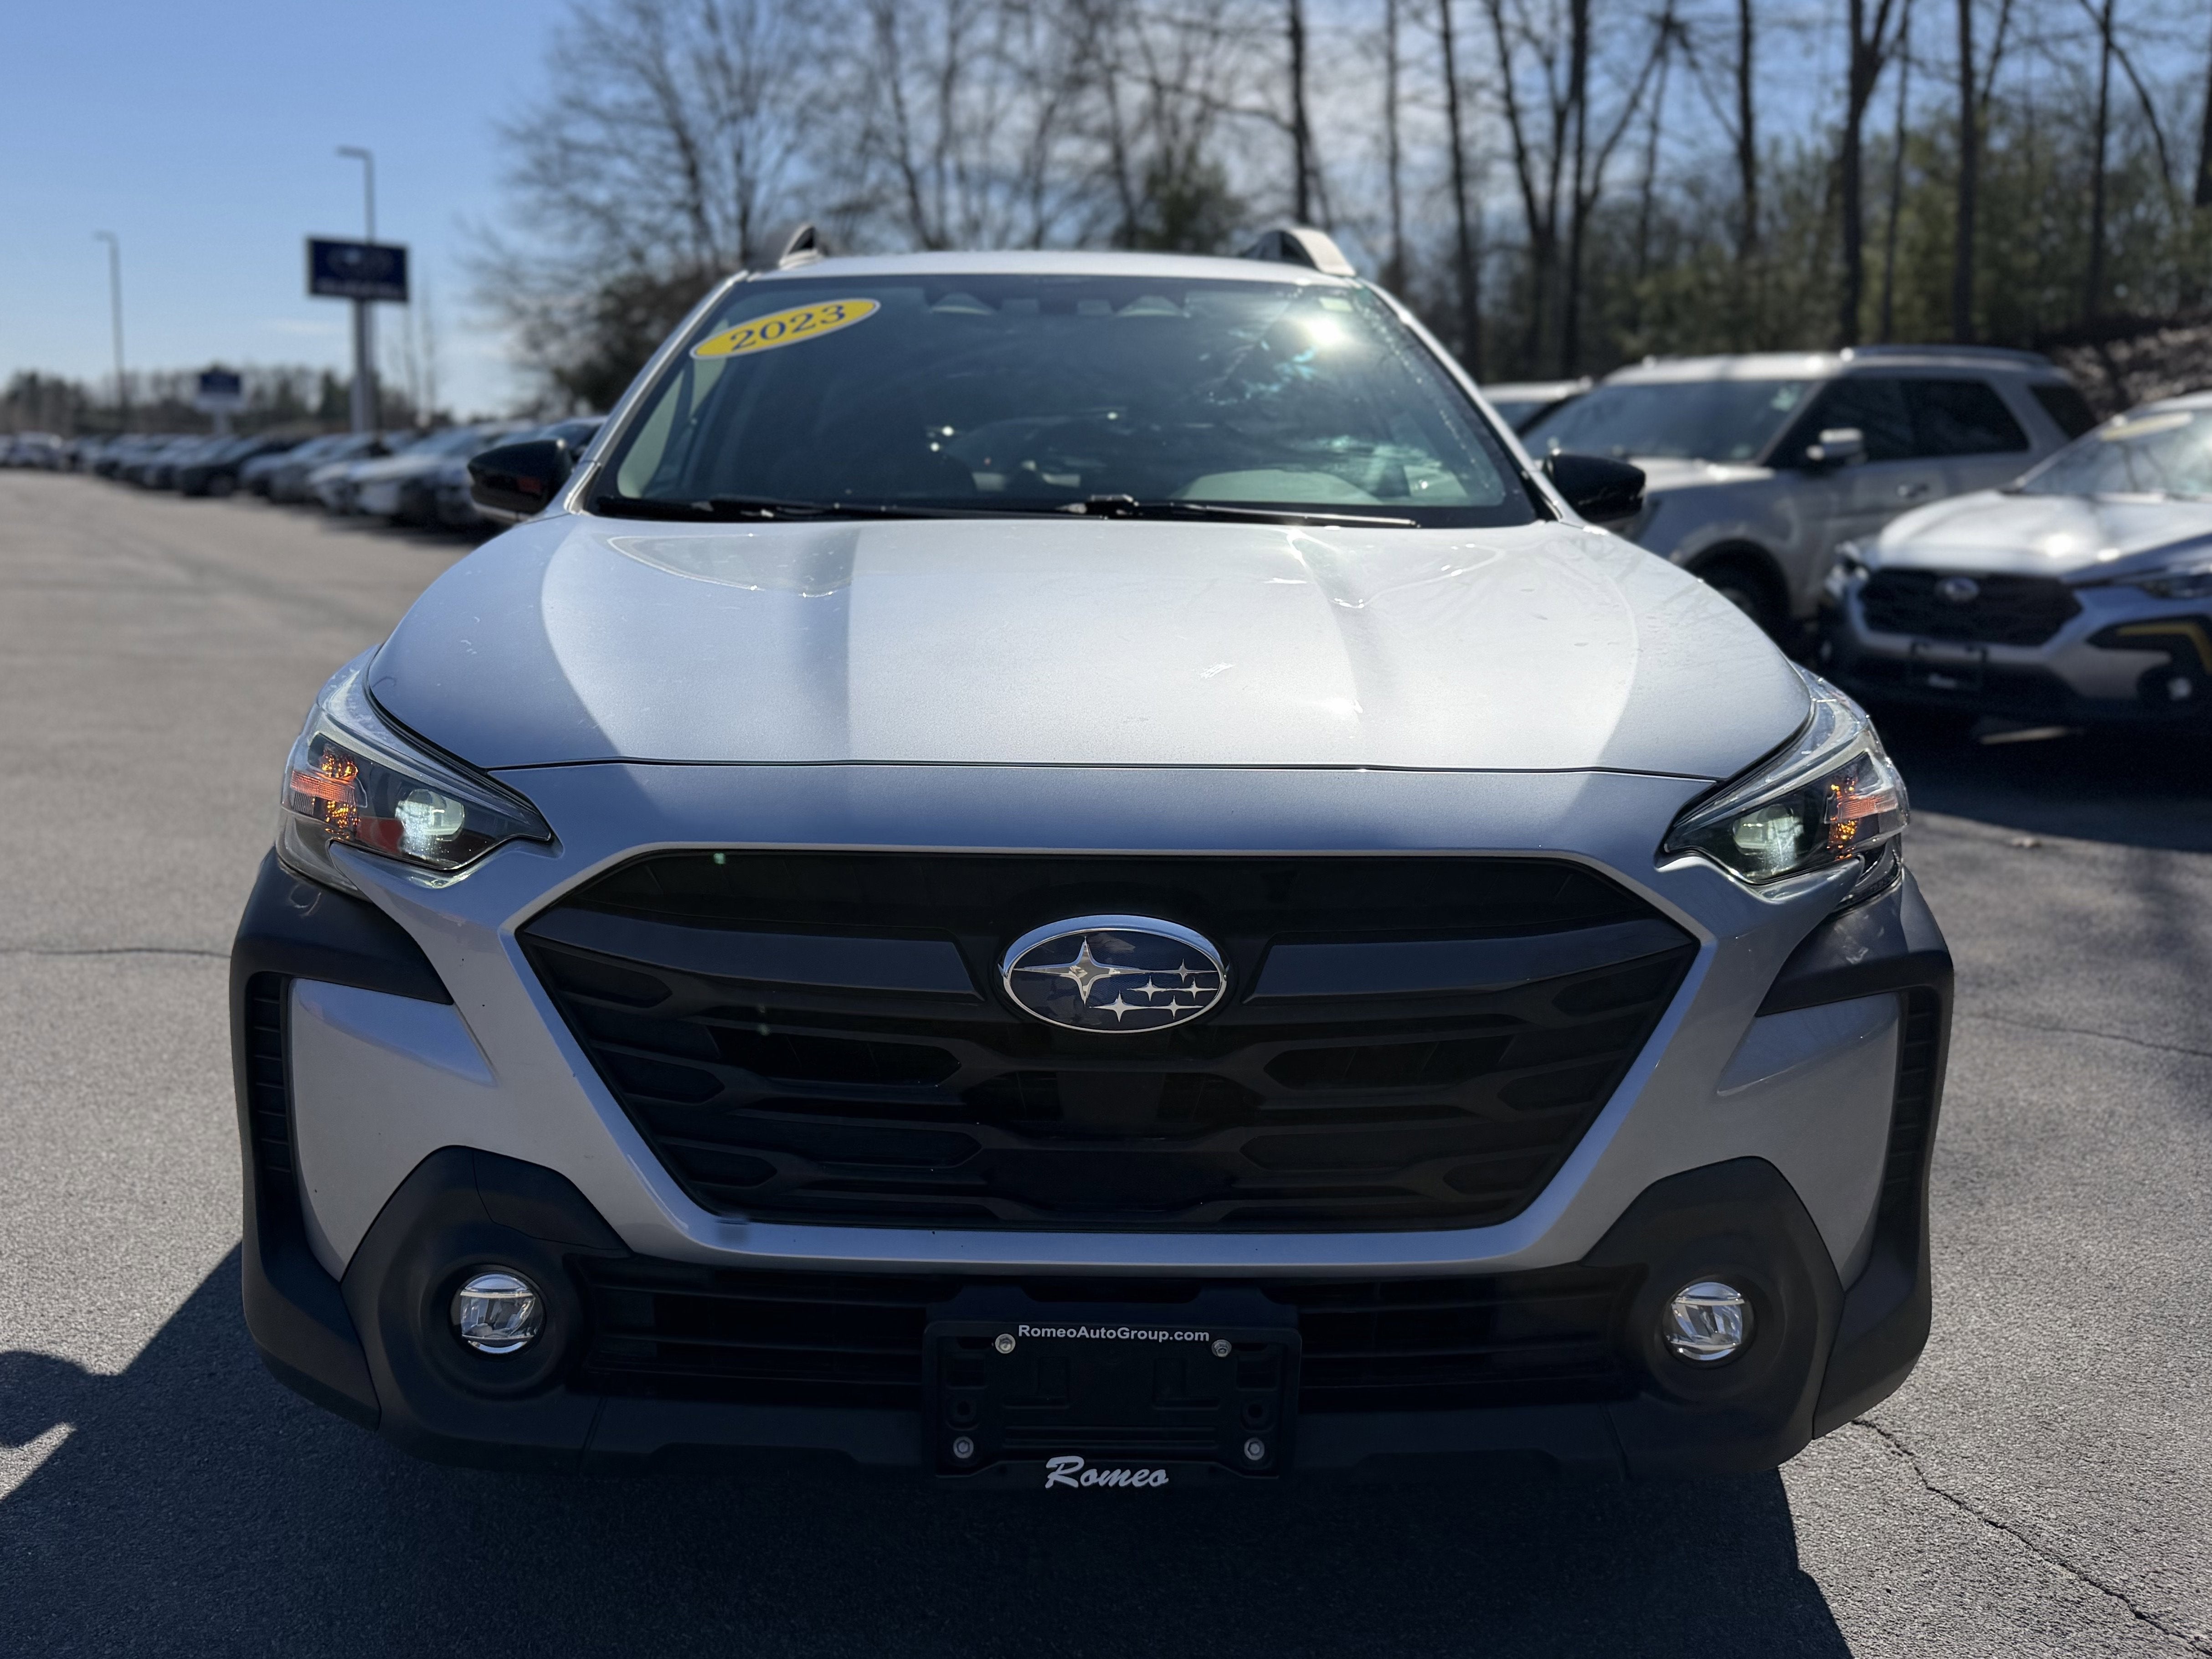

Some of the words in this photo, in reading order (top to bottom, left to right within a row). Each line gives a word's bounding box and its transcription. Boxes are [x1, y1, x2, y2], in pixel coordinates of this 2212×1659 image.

[730, 304, 846, 351] 2023
[1018, 1324, 1209, 1343] RomeoAutoGroup.com
[1045, 1455, 1169, 1489] Romeo
